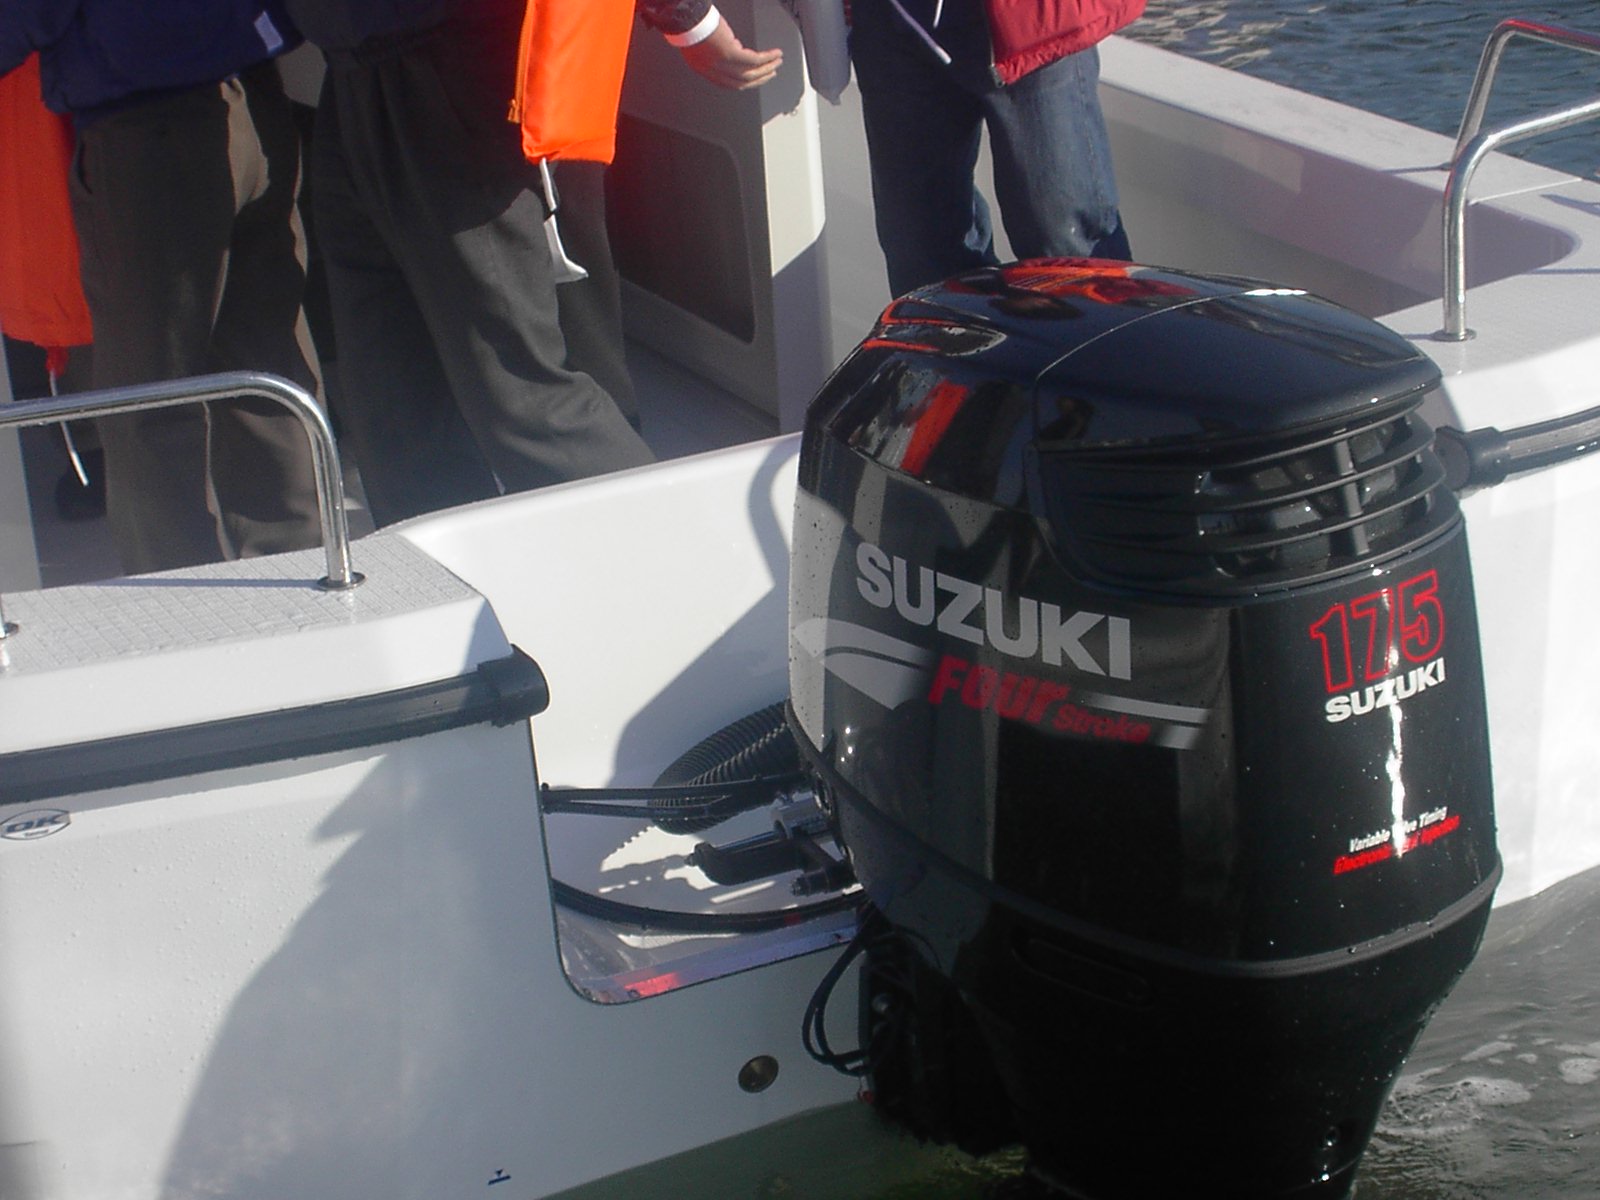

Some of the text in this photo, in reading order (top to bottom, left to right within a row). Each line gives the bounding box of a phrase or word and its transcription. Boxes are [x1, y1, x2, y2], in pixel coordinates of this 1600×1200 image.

[855, 542, 1131, 681] SUZUKI
[1309, 568, 1446, 693] 175
[1325, 657, 1446, 723] SUZUKI
